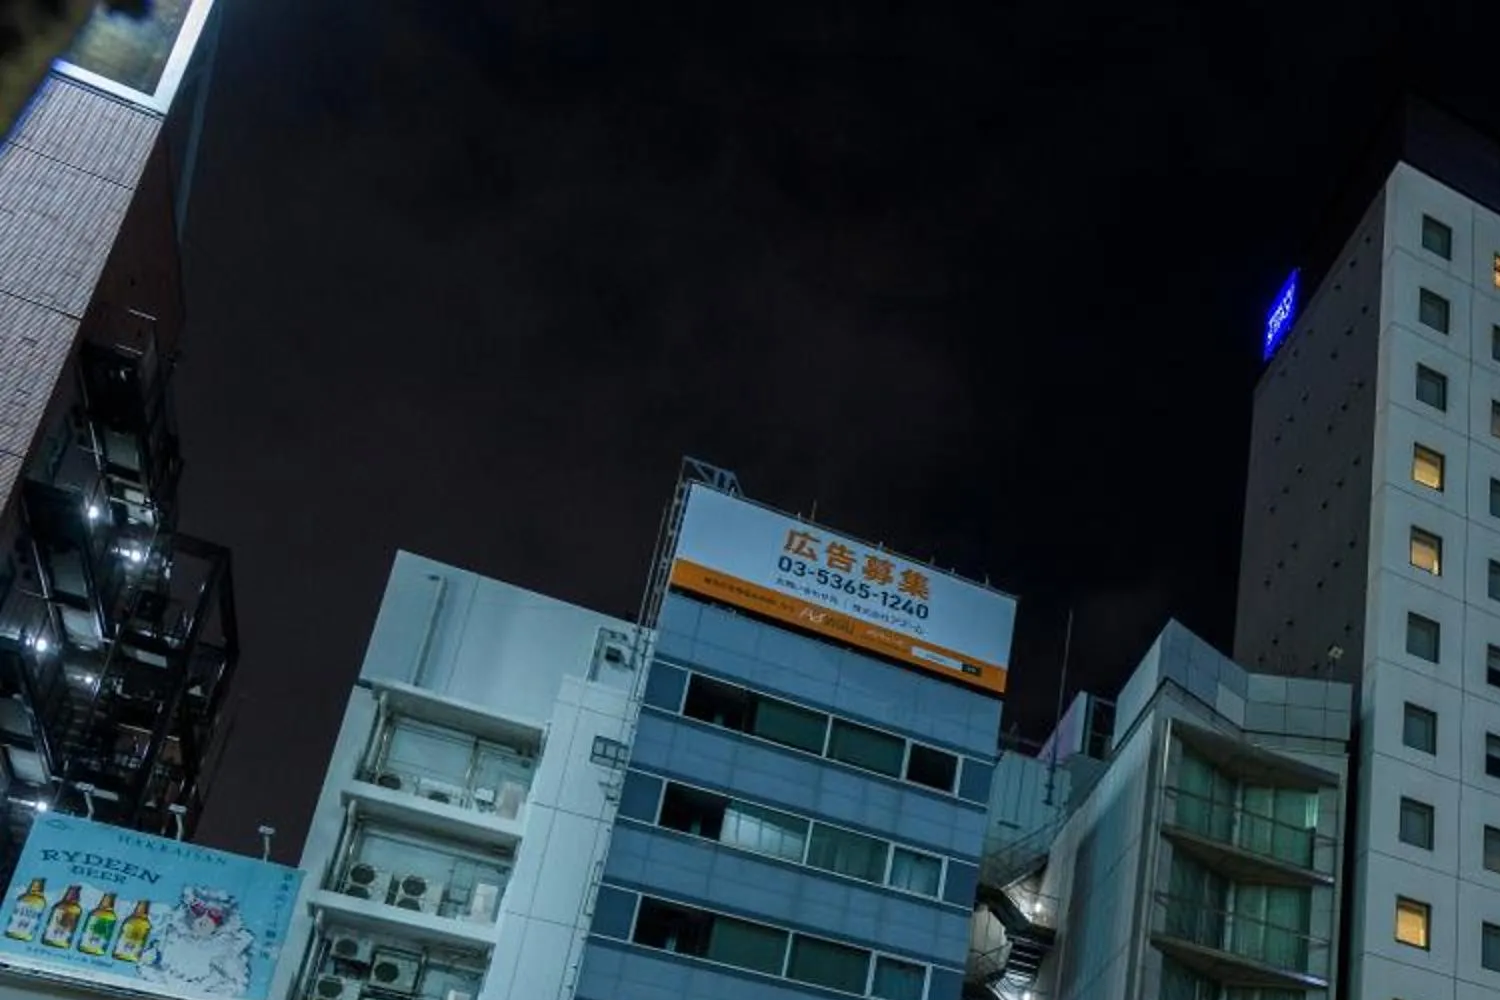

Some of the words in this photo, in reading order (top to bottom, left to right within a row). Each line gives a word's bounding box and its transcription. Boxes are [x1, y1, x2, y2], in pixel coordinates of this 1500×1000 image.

[777, 555, 930, 619] 03-5365-1240
[783, 528, 930, 600] 広告募集
[40, 848, 162, 885] RYDEEN
[70, 864, 128, 885] BEER
